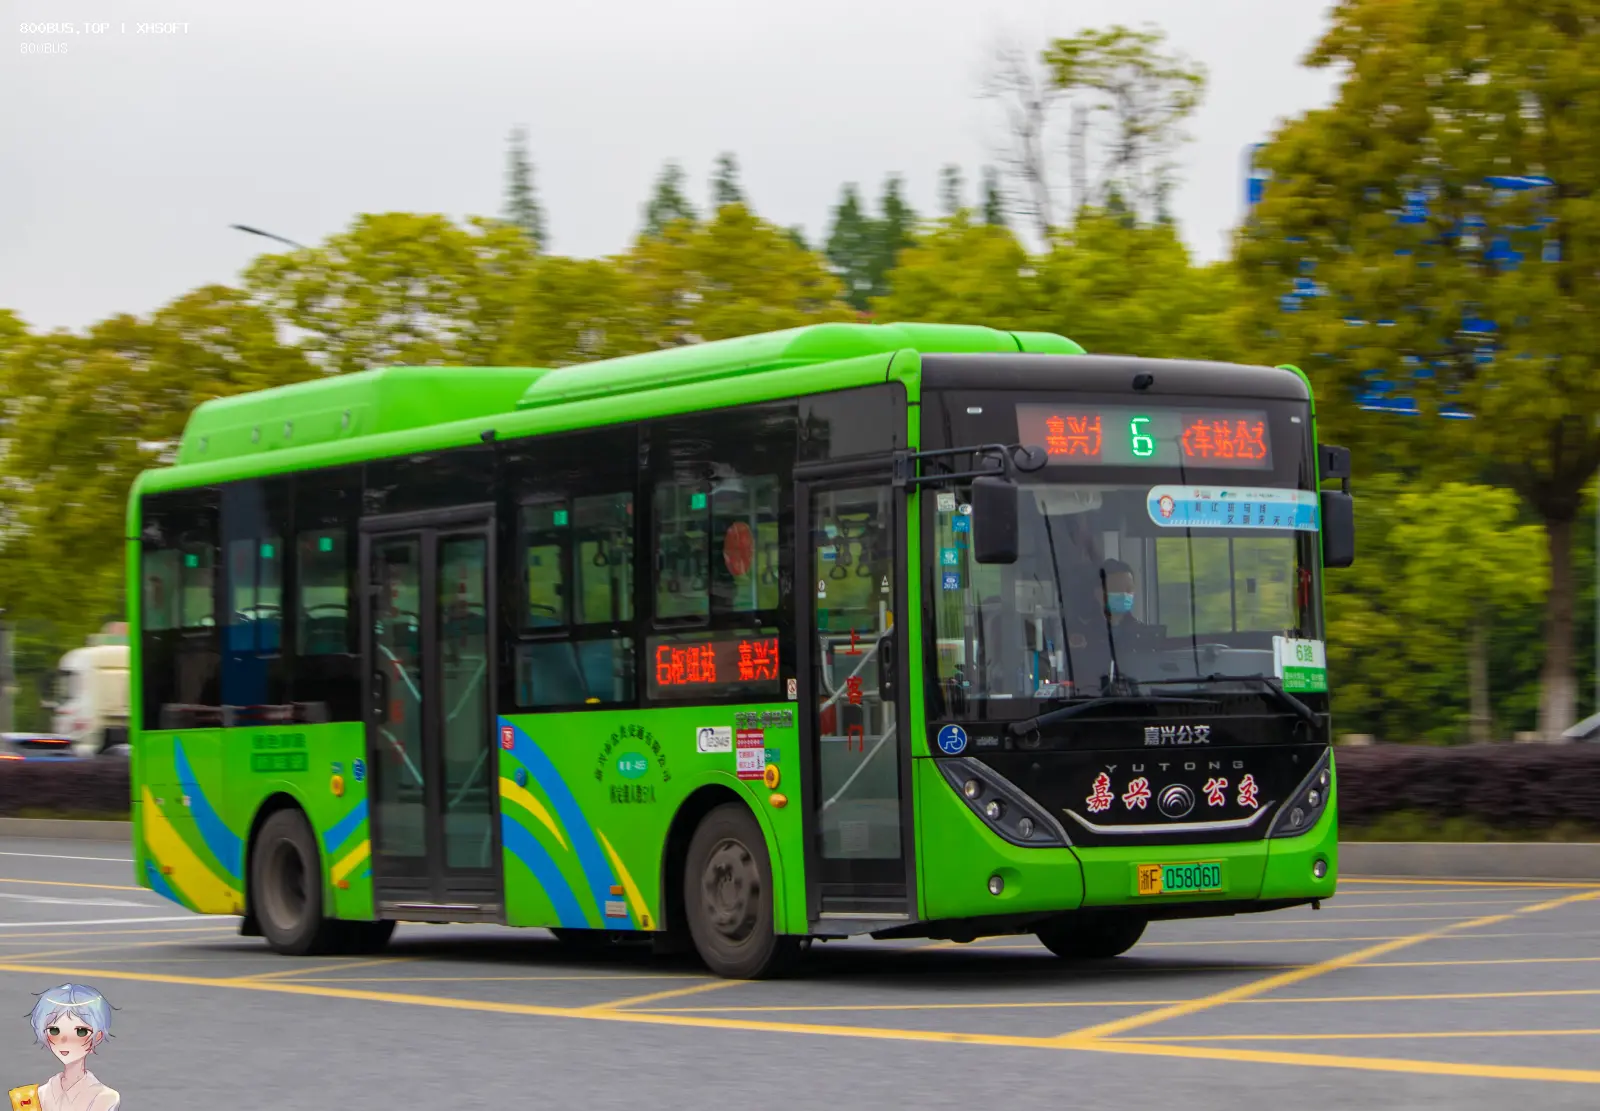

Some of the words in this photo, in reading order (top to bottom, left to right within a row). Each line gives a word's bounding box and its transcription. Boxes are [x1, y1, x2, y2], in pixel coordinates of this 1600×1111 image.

[1130, 416, 1154, 457] 6
[1143, 725, 1211, 746] 嘉兴公交
[1105, 760, 1244, 773] YUTONG
